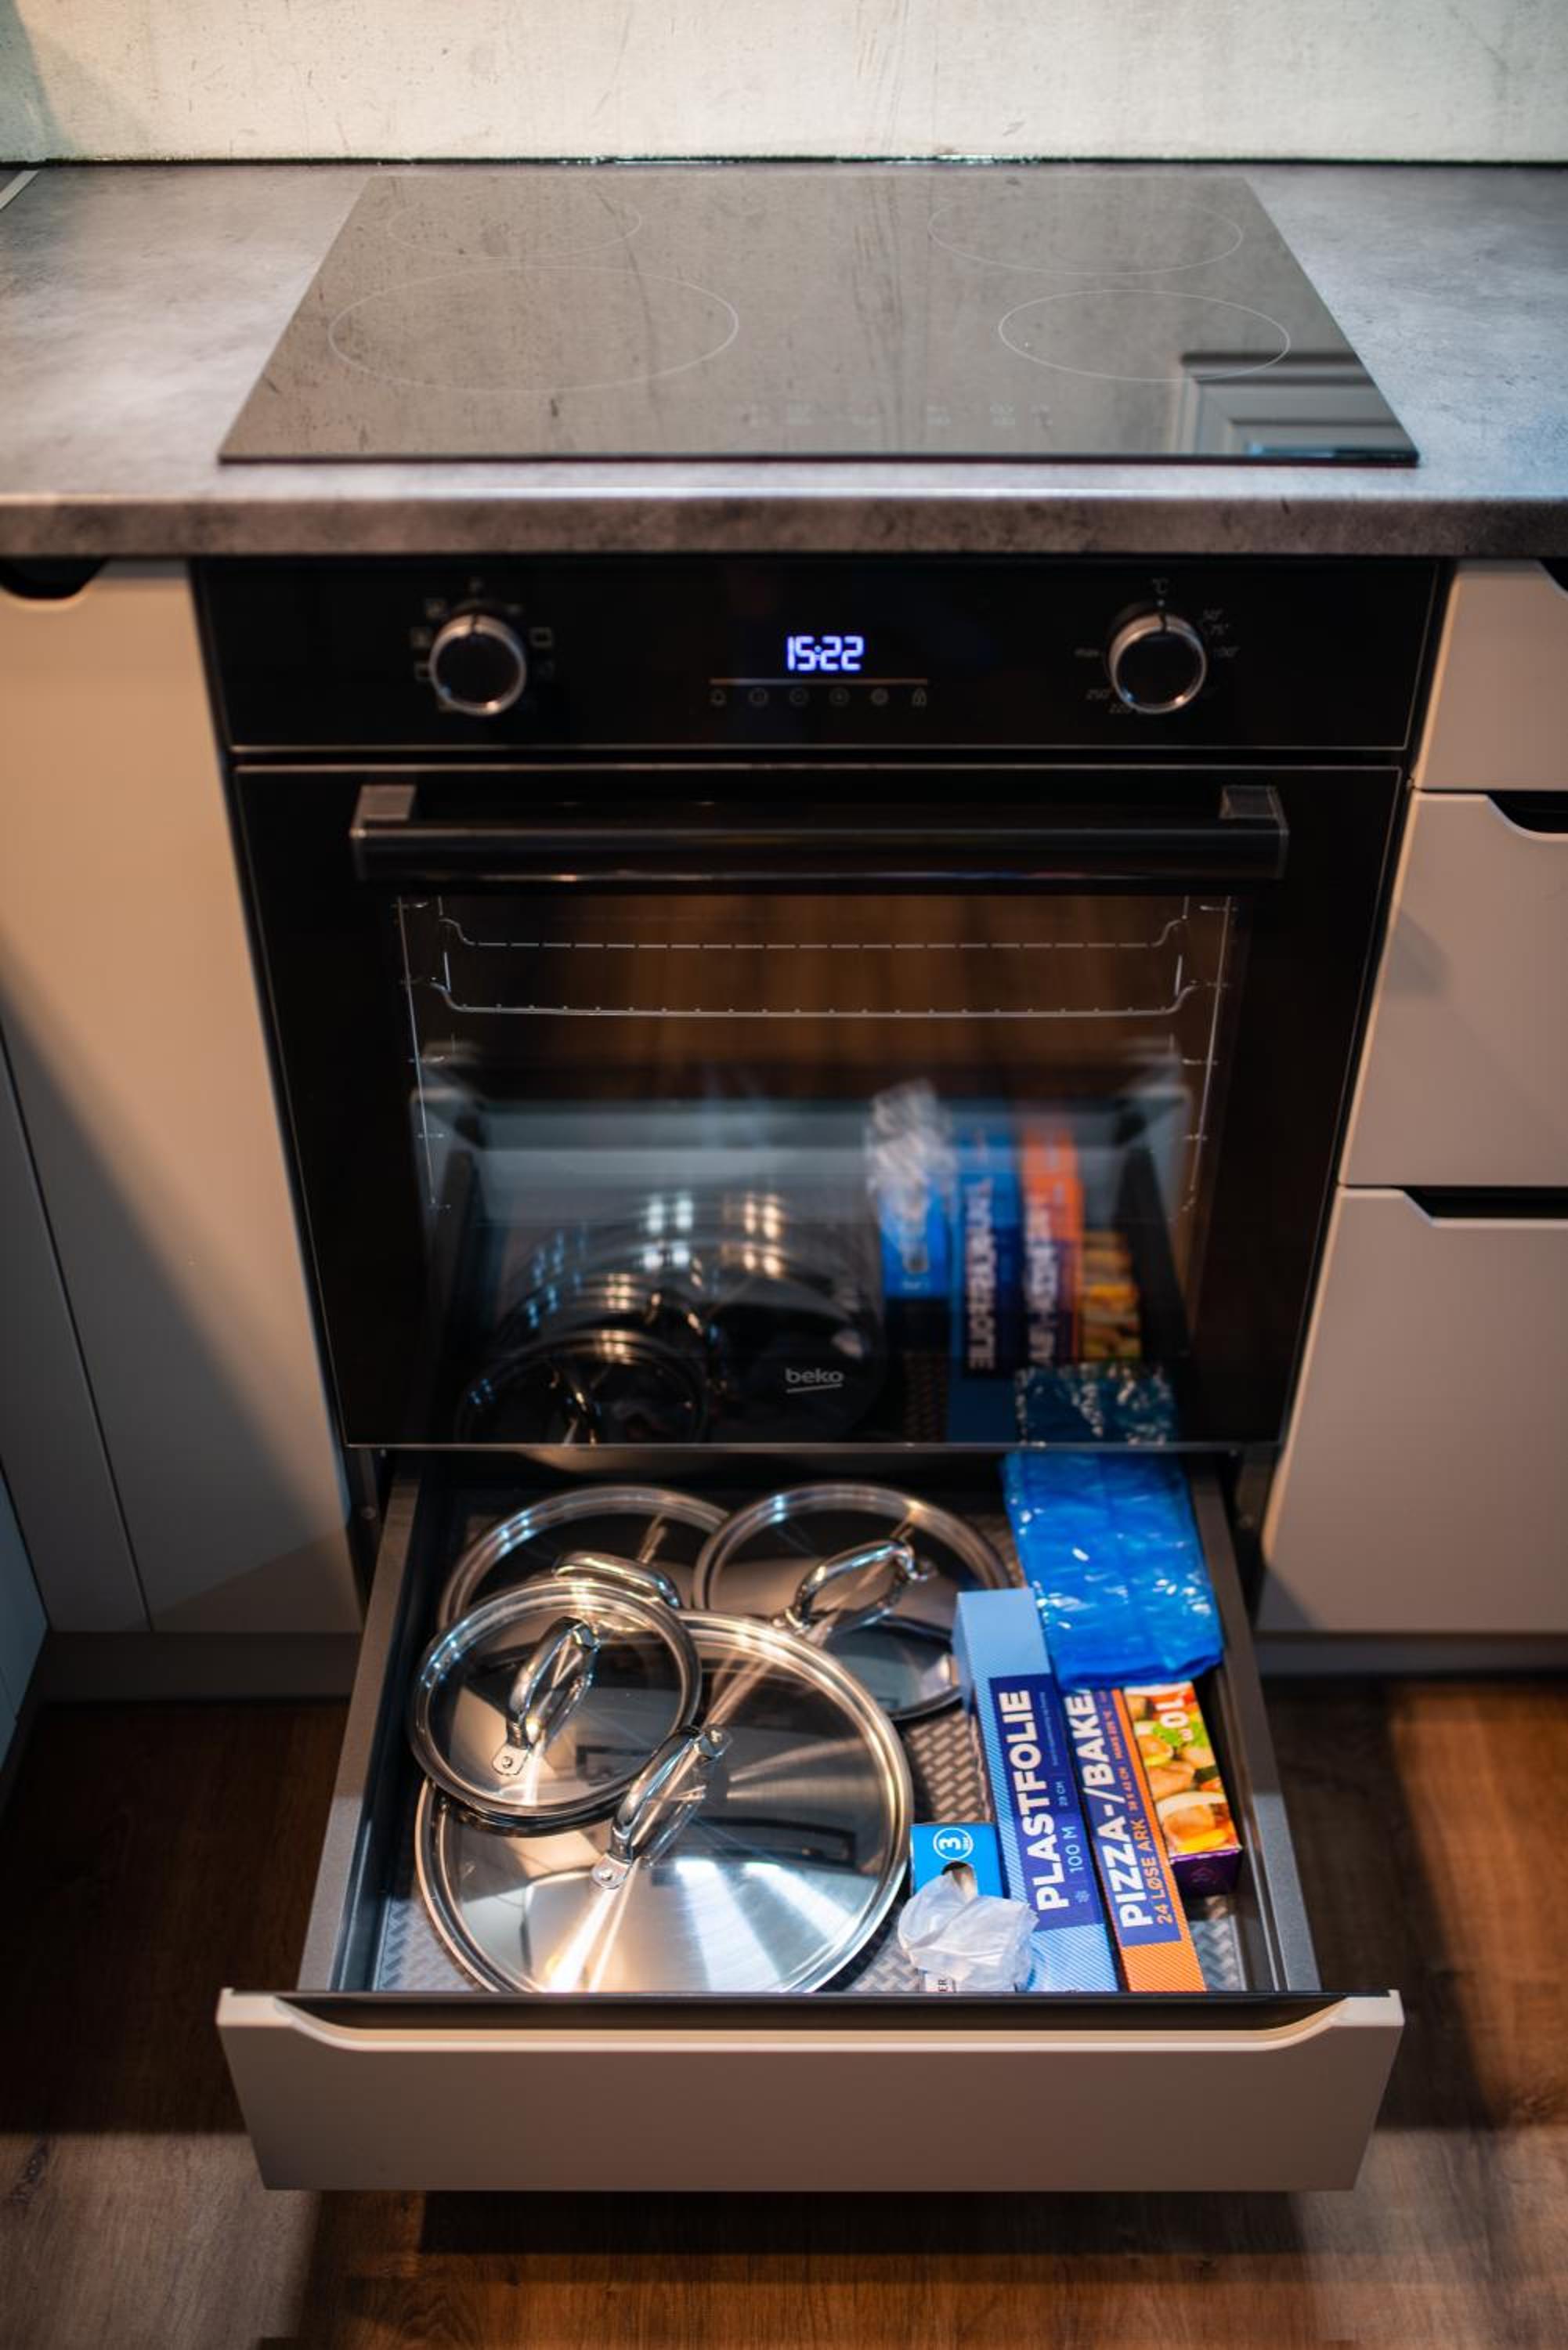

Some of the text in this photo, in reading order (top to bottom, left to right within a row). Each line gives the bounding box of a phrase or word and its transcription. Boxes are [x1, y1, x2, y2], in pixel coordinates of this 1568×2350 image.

[786, 635, 864, 671] 15:22
[786, 1368, 844, 1383] beko
[999, 1690, 1069, 1911] PLASTFOLIE
[1064, 1689, 1154, 1928] PIZZA-/BAKE
[939, 1837, 962, 1850] 3
[1060, 1826, 1078, 1840] M
[1130, 1818, 1154, 1852] ARK
[1065, 1844, 1085, 1873] 100
[1154, 1904, 1173, 1925] 24
